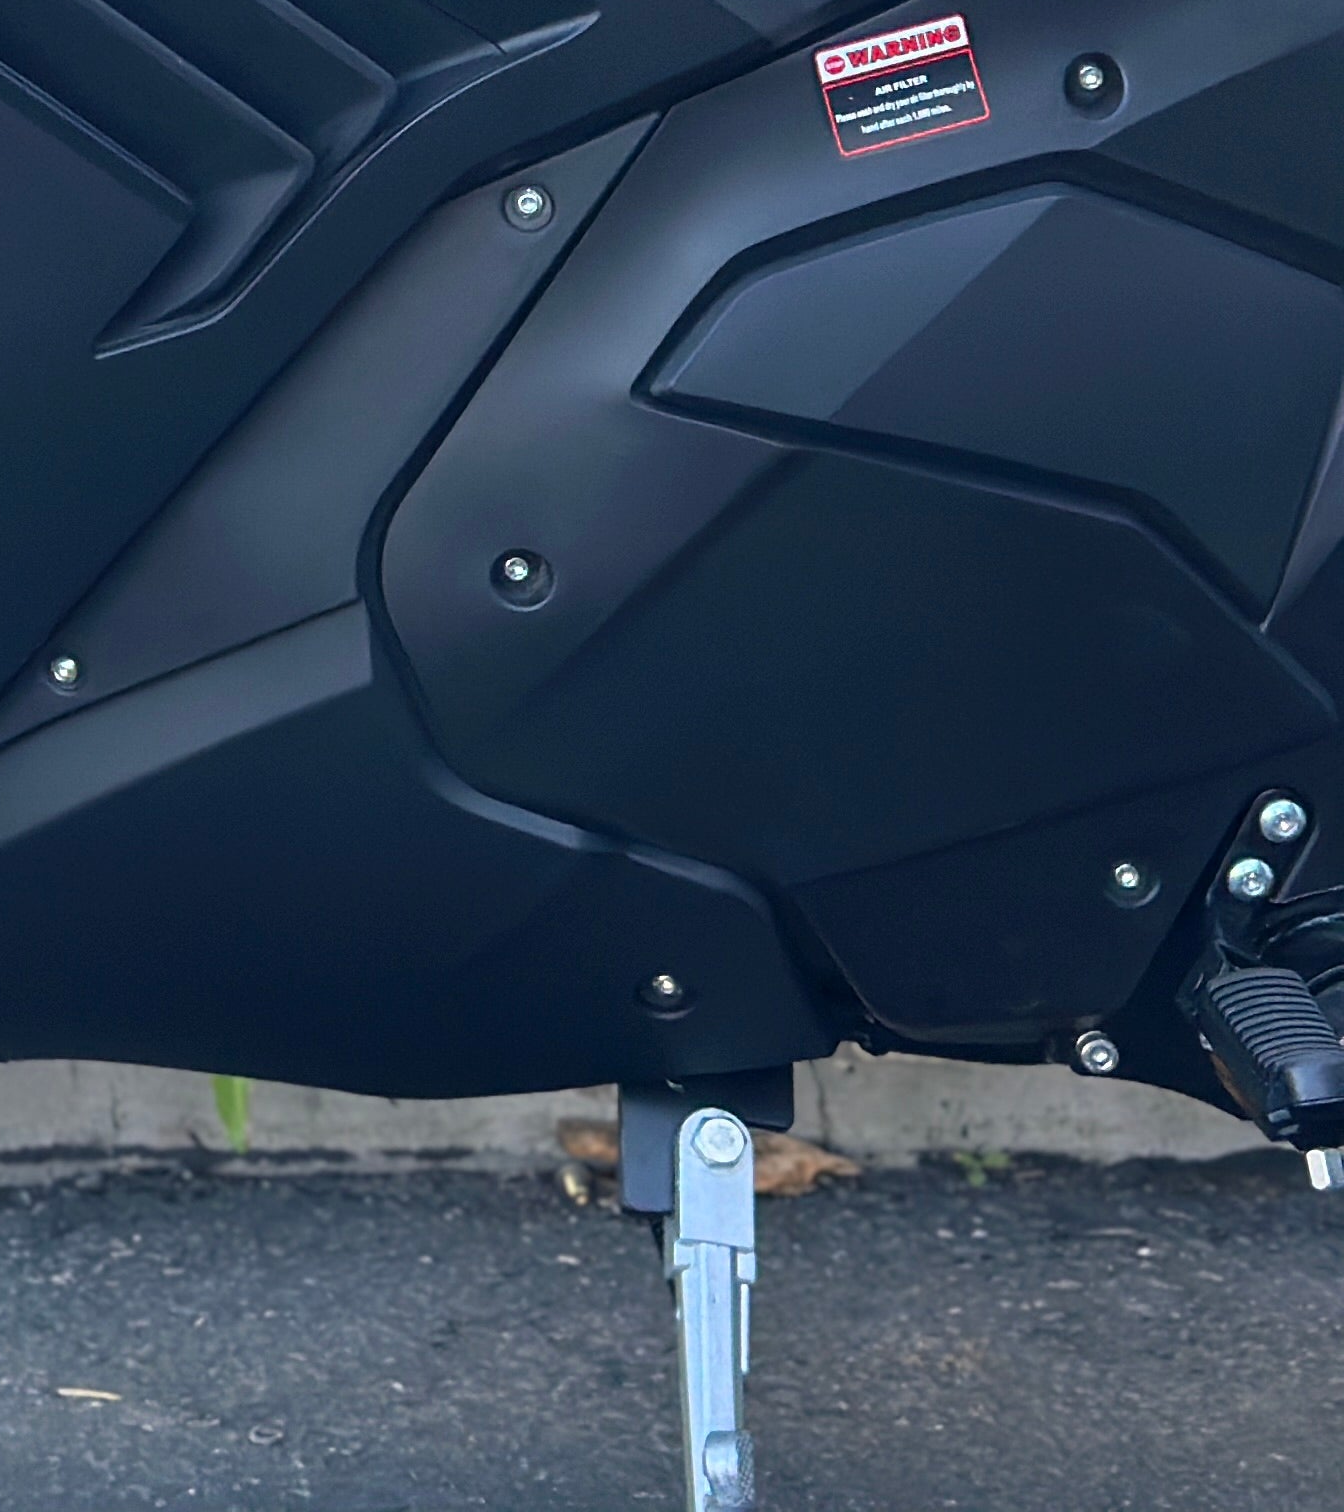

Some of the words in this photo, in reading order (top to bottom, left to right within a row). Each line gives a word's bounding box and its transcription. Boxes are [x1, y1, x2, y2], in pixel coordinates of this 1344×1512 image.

[846, 24, 961, 69] WARNING
[875, 83, 893, 96] AIR
[892, 74, 928, 91] FILTER
